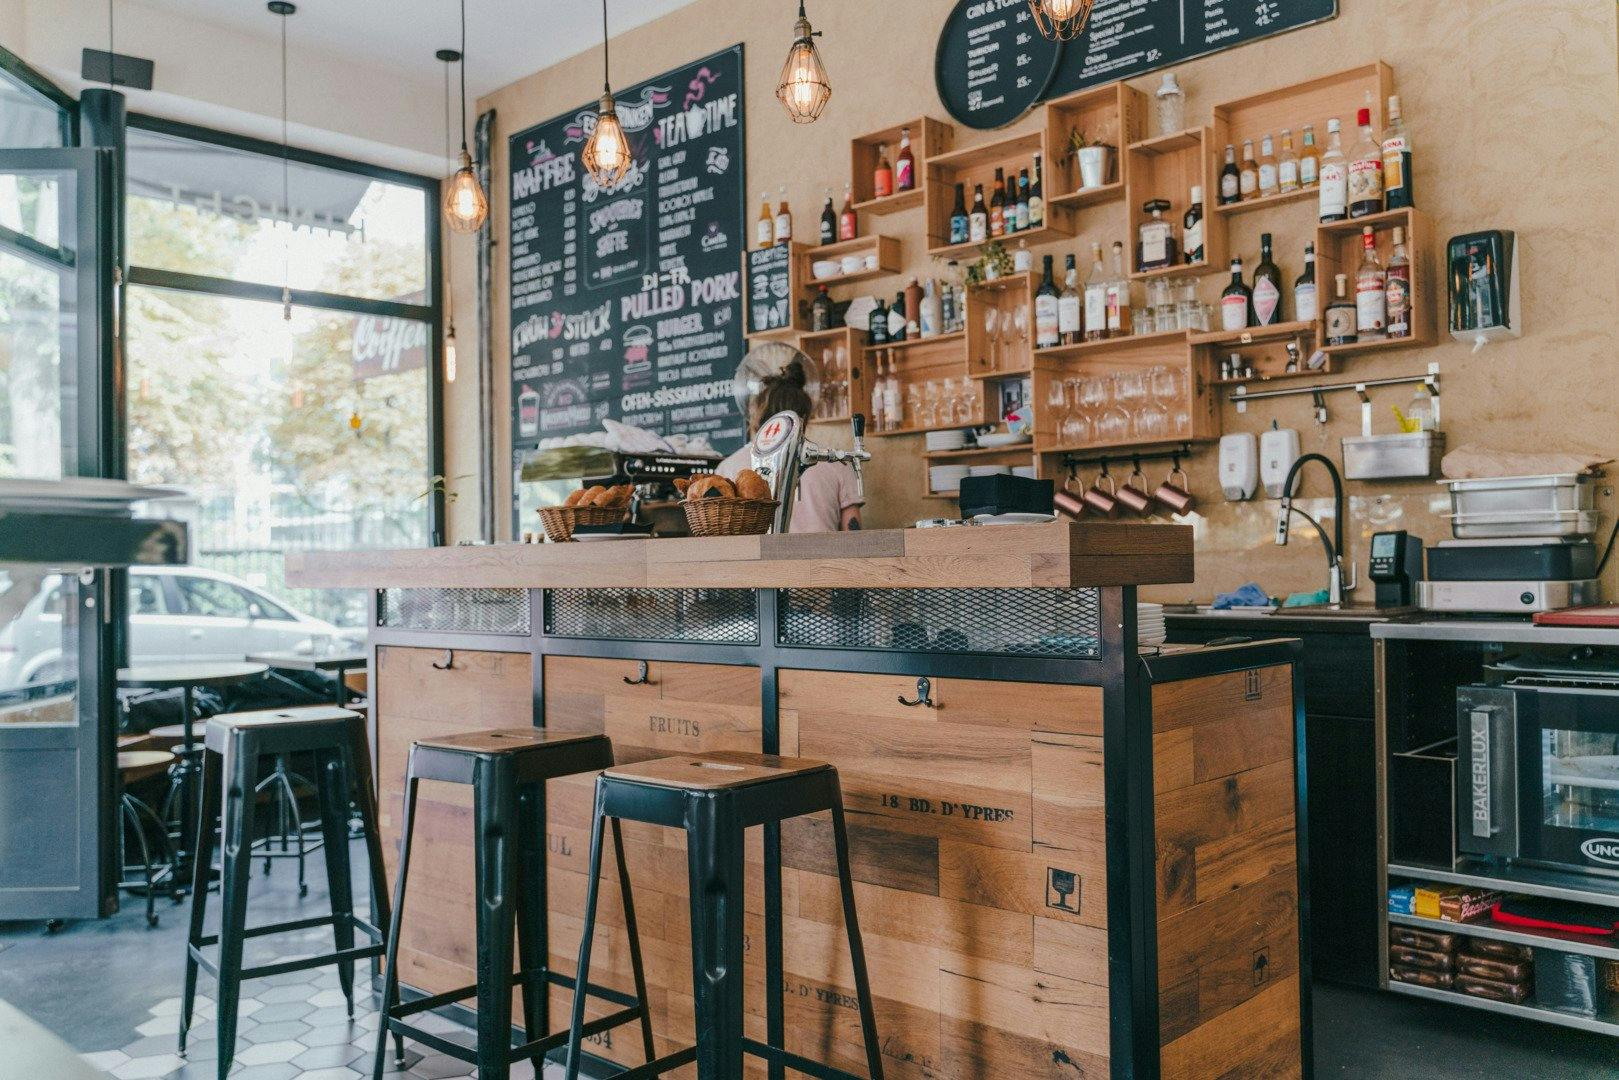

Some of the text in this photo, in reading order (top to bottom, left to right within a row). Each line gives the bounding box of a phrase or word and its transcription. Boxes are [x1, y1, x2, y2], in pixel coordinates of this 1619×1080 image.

[658, 111, 687, 149] TEA
[620, 270, 741, 322] PULLED PORK
[648, 715, 701, 737] FRUITS
[1471, 728, 1488, 821] BAKERLUX
[879, 794, 899, 810] 18
[908, 797, 937, 815] BD.
